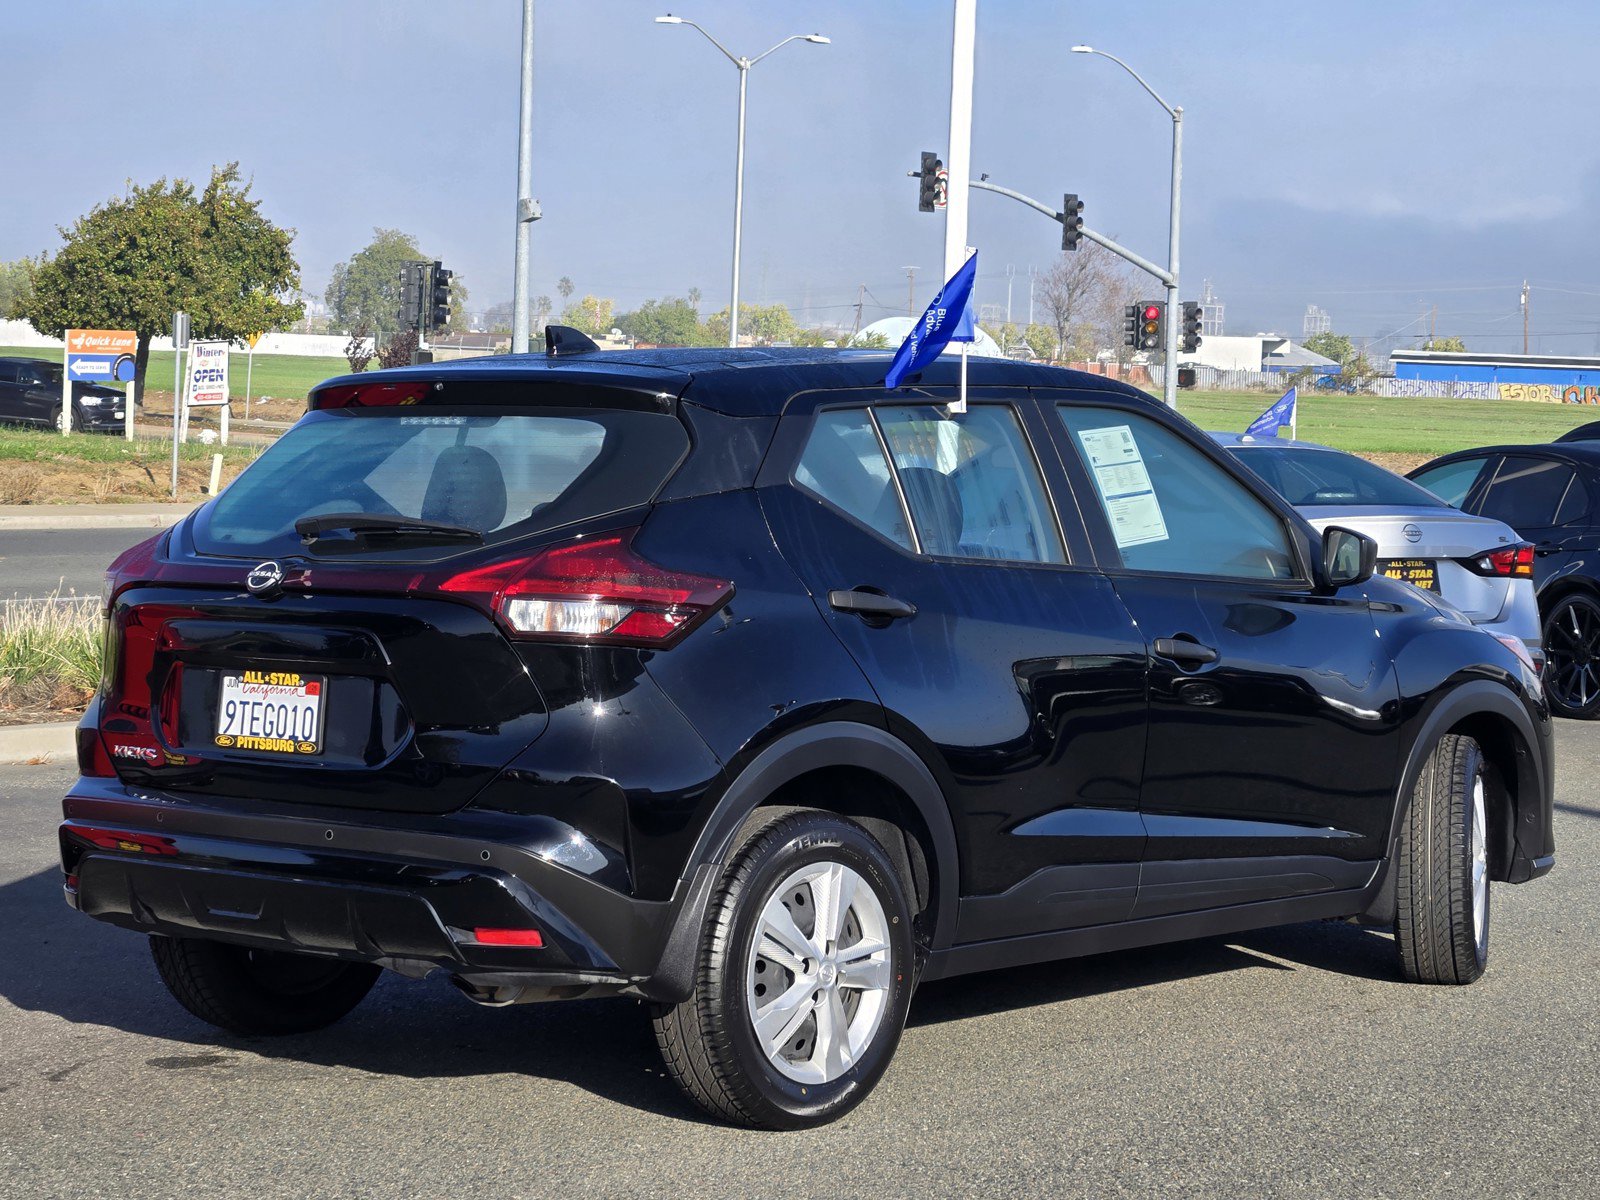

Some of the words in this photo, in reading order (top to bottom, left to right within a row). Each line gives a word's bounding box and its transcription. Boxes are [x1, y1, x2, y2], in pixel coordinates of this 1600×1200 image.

[934, 308, 947, 332] Blue
[85, 335, 110, 347] Quick
[111, 336, 132, 346] Lane
[194, 368, 224, 382] OPEN
[1384, 570, 1402, 580] ALL
[1409, 569, 1434, 579] STAR
[242, 671, 265, 684] ALL
[269, 672, 300, 687] STAR
[243, 682, 306, 700] California
[223, 700, 314, 741] 9TEG010
[114, 744, 158, 760] KICKS
[236, 736, 295, 752] PITTSBURG
